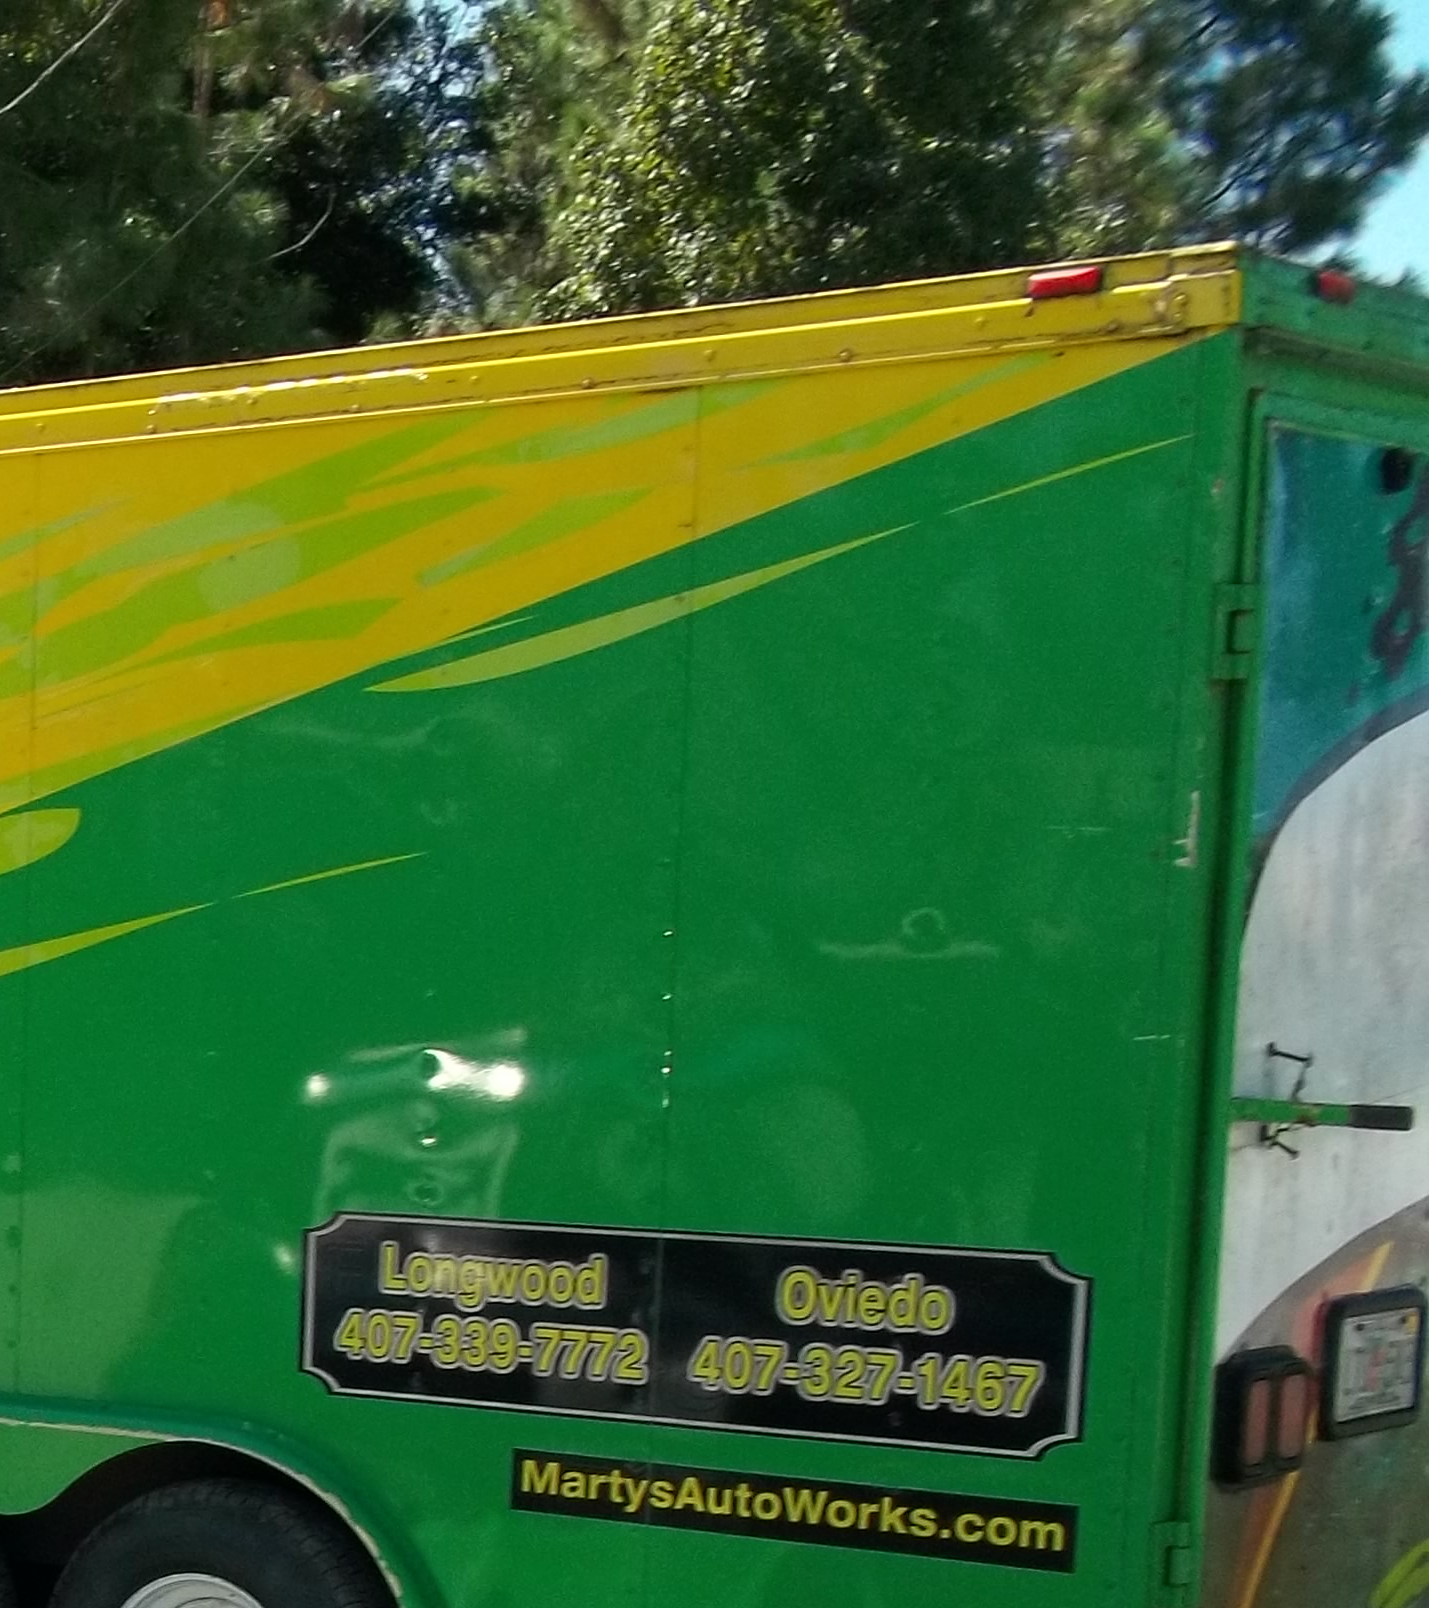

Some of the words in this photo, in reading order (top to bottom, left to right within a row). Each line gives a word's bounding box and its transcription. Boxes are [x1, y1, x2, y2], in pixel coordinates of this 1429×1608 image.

[379, 1241, 608, 1311] Longwood
[776, 1265, 956, 1335] Oviedo
[334, 1308, 649, 1385] 407-339-7772
[688, 1335, 1045, 1418] 407-327-1467
[520, 1458, 1066, 1554] MartysAutoWorks.com
